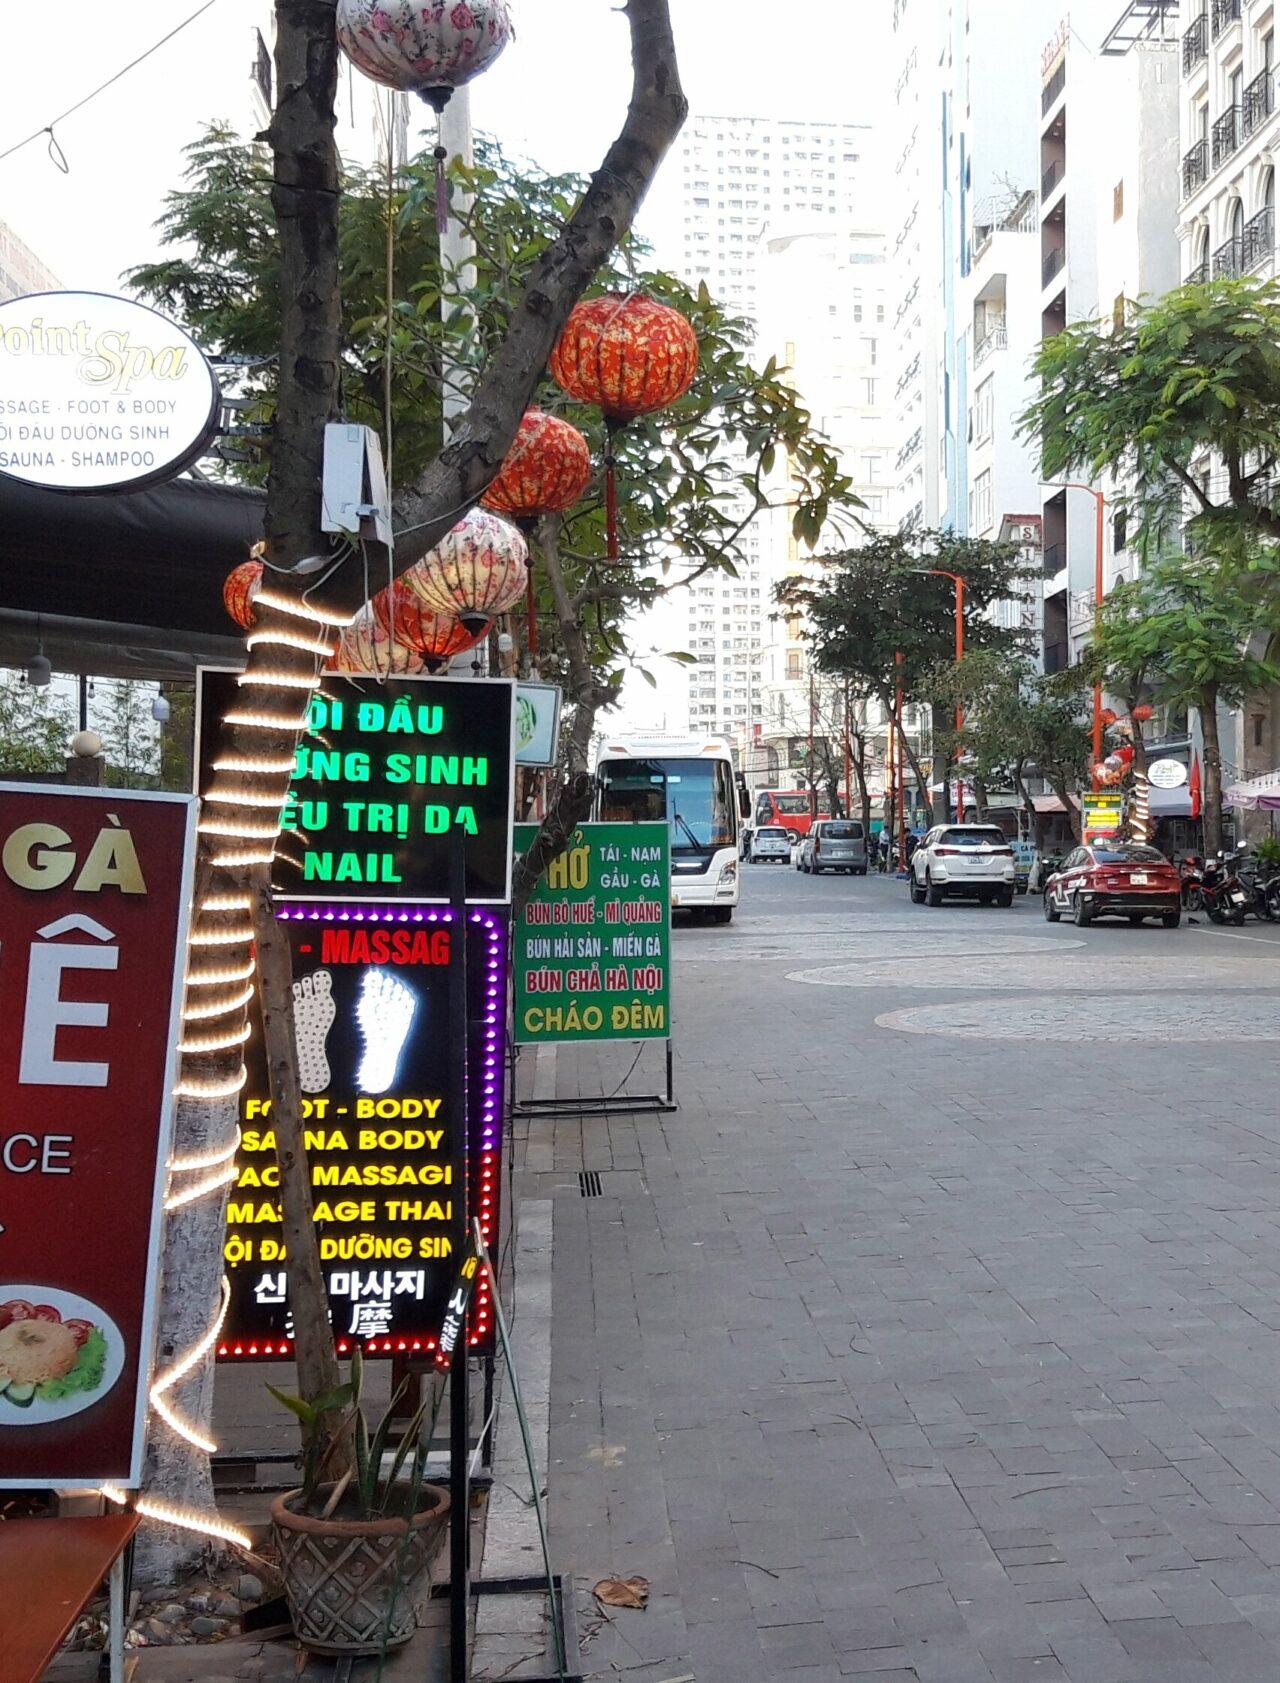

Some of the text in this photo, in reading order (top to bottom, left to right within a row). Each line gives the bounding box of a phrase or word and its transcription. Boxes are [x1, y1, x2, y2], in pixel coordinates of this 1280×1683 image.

[0, 318, 188, 395] oint Spa
[68, 400, 112, 414] FOOT
[117, 400, 126, 414] &
[133, 400, 176, 414] BODY
[130, 425, 169, 440] SINH
[0, 451, 155, 467] SAUNA SHAMPOO
[357, 694, 443, 735] ĐẦU
[386, 752, 488, 786] SINH
[343, 802, 409, 839] TRỊ
[424, 805, 479, 835] DA
[2, 814, 148, 895] GÀ
[304, 851, 402, 883] NAIL
[532, 829, 592, 890] HỞ
[600, 843, 620, 862] TÁI
[631, 847, 661, 866] NẠM
[600, 866, 629, 888] GẦU
[640, 869, 661, 888] GÀ
[526, 898, 550, 925] BÚN
[572, 895, 596, 924] HUẾ
[622, 895, 662, 926] QUẢNG
[321, 930, 451, 965] MASSAG
[526, 933, 550, 959] BÚN
[554, 931, 574, 958] HẢI
[577, 931, 601, 958] SẢN
[613, 930, 642, 957] MIẾN
[646, 932, 662, 957] GÀ
[526, 962, 662, 995] BÚN CHẢ HÀ NỘI
[524, 998, 664, 1033] CHÁO ĐÊM
[356, 1099, 442, 1120] BODY
[2, 1132, 74, 1175] CE
[242, 1129, 445, 1152] SANA BODY
[226, 1200, 375, 1224] MAAGE
[320, 1233, 412, 1260] DƯỠNG
[419, 1236, 452, 1259] SIN
[330, 1270, 425, 1302] 마사지
